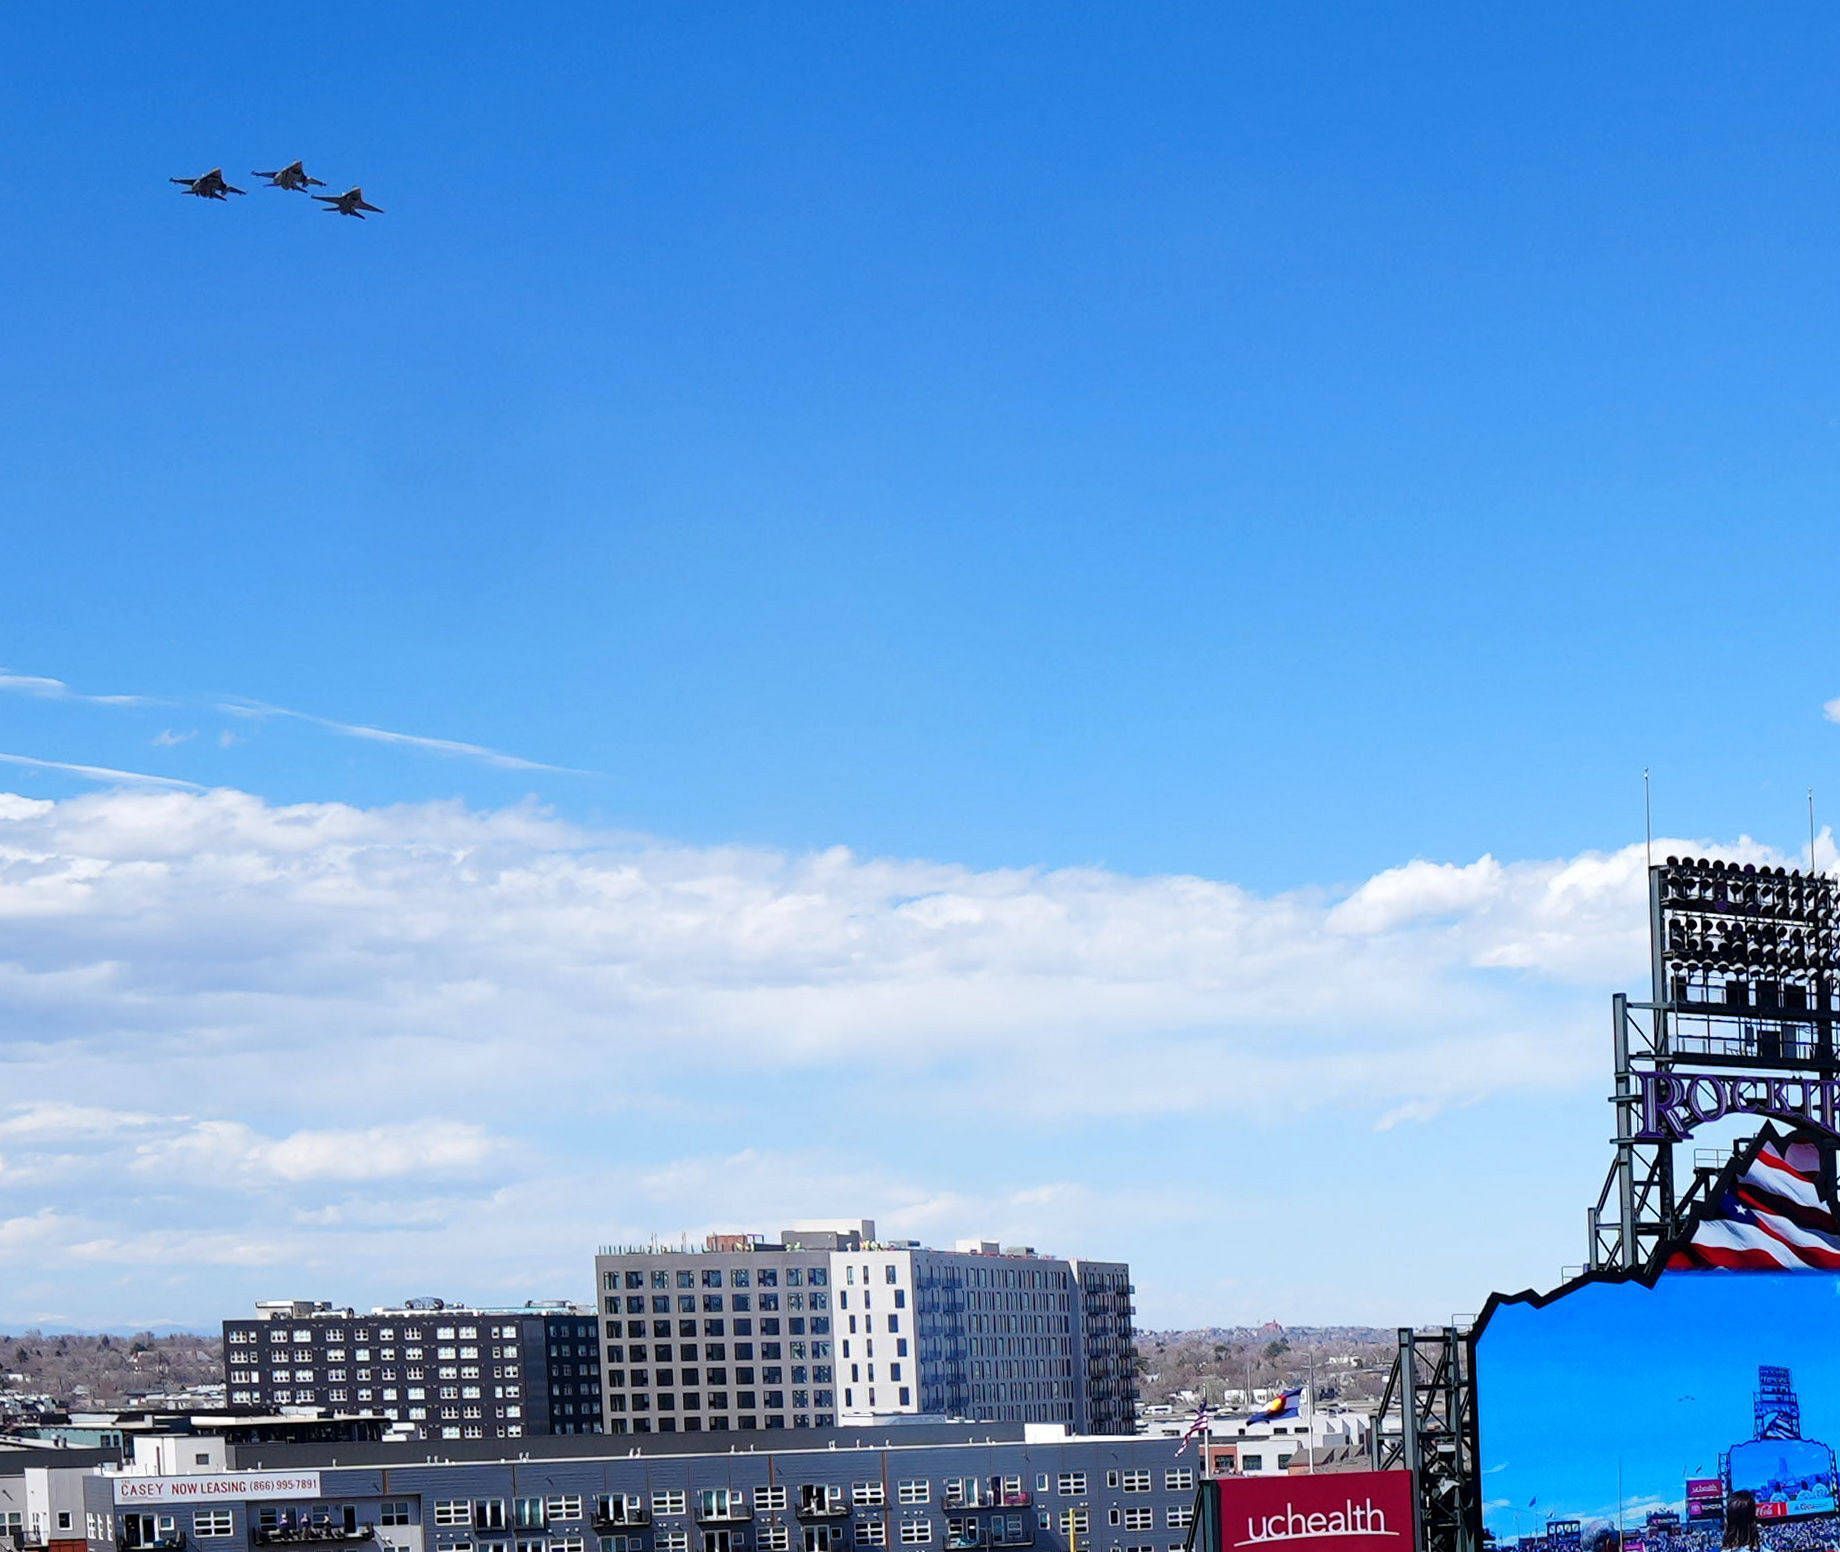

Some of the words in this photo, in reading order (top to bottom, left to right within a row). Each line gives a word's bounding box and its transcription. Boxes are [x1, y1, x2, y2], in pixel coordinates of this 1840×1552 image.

[121, 1483, 163, 1496] CASEY
[171, 1484, 197, 1496] NOW
[200, 1481, 246, 1494] LEASING
[249, 1479, 275, 1491] (866)
[276, 1479, 317, 1490] 995-7891
[1248, 1498, 1386, 1540] uchealth
